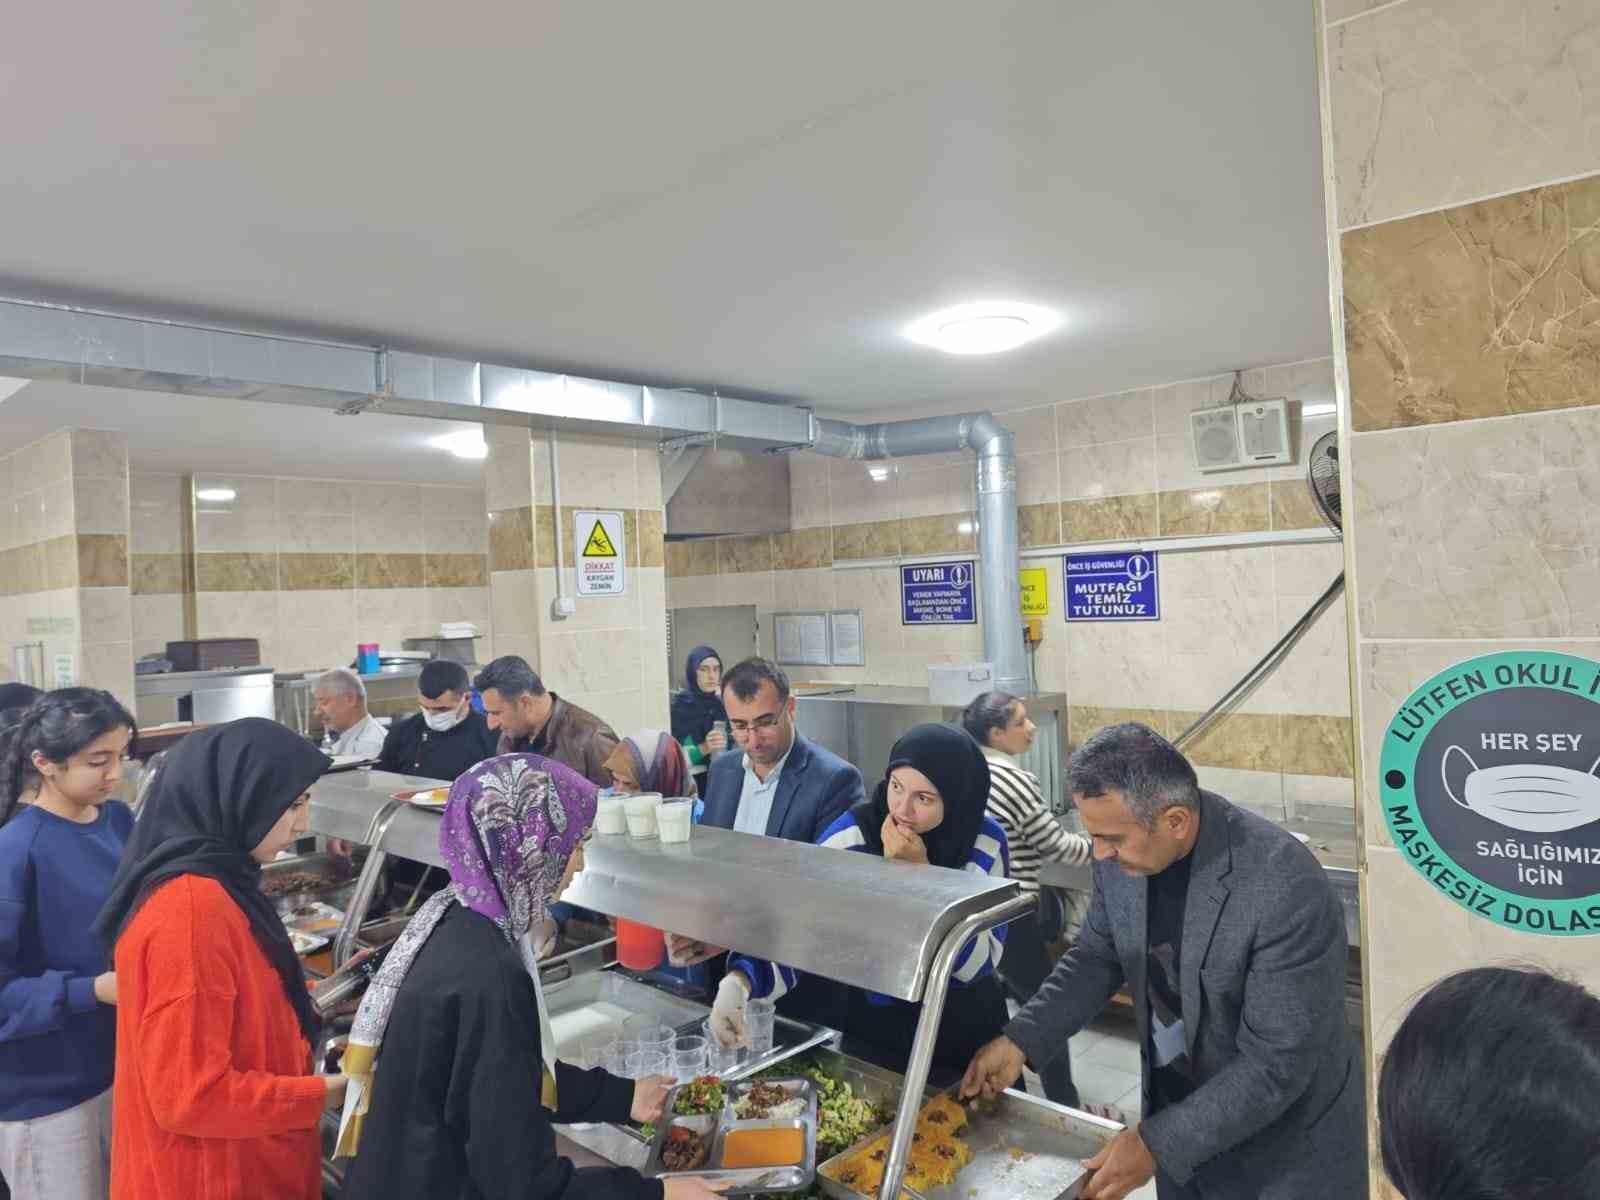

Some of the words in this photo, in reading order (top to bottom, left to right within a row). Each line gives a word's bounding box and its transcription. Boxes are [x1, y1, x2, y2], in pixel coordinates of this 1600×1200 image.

[585, 562, 615, 570] DİKKAT
[913, 568, 944, 582] UYARI
[1074, 580, 1143, 594] MUTFAĞI
[1086, 592, 1132, 604] TEMİZ
[1074, 604, 1147, 615] TUTUNUZ
[1391, 669, 1488, 743] LÜTFEN
[1494, 663, 1580, 690] OKUL
[1480, 732, 1529, 750] HER
[1535, 733, 1583, 752] ŞEY
[1388, 804, 1497, 916] MASKESİZ
[1476, 838, 1600, 865] SAĞLIĞIMIZ
[1517, 863, 1564, 886] İÇİN
